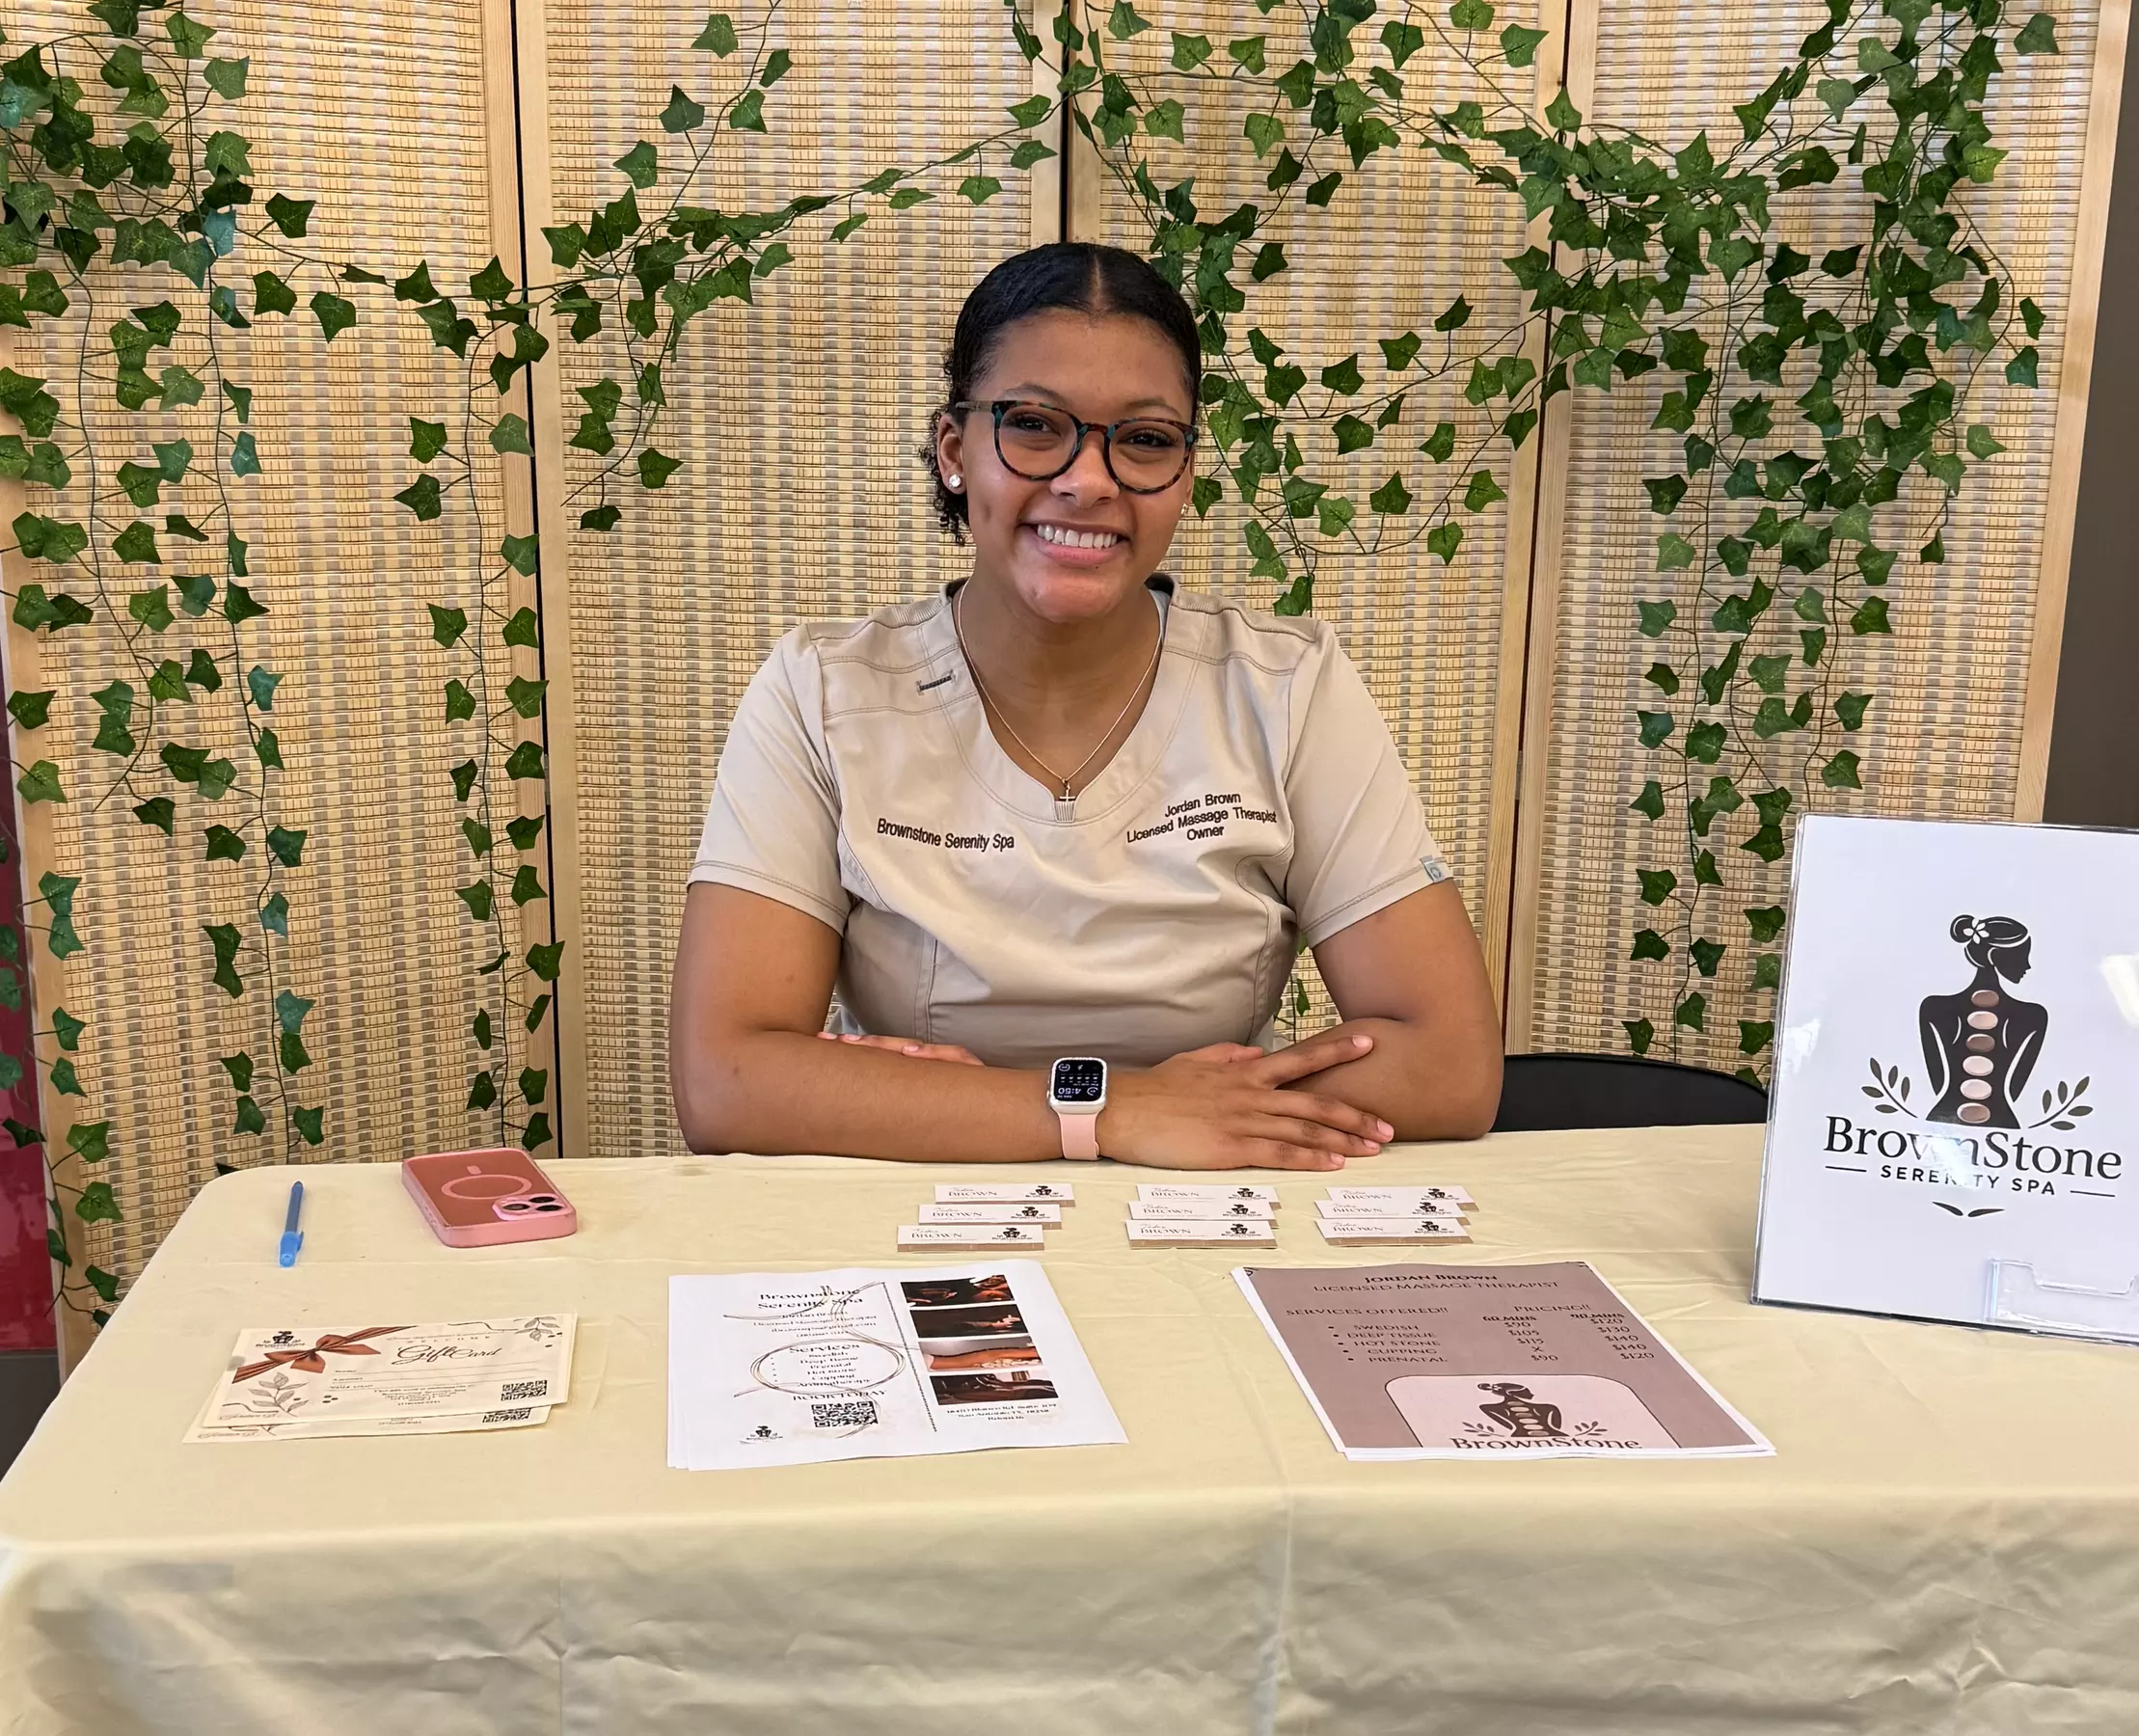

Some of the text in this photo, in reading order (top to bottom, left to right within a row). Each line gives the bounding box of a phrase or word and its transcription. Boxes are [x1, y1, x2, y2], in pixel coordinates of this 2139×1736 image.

[1165, 793, 1241, 817] Jordan Brown
[1126, 806, 1277, 843] Licensed Massage Therapist
[1186, 826, 1225, 841] Owner
[877, 818, 1015, 853] Brownstone Serenity Spa
[1881, 1164, 2055, 1195] SERETY SPA
[1364, 1274, 1431, 1284] JORDAN
[789, 1344, 860, 1353] Services
[1449, 1437, 1643, 1450] BrownStone
